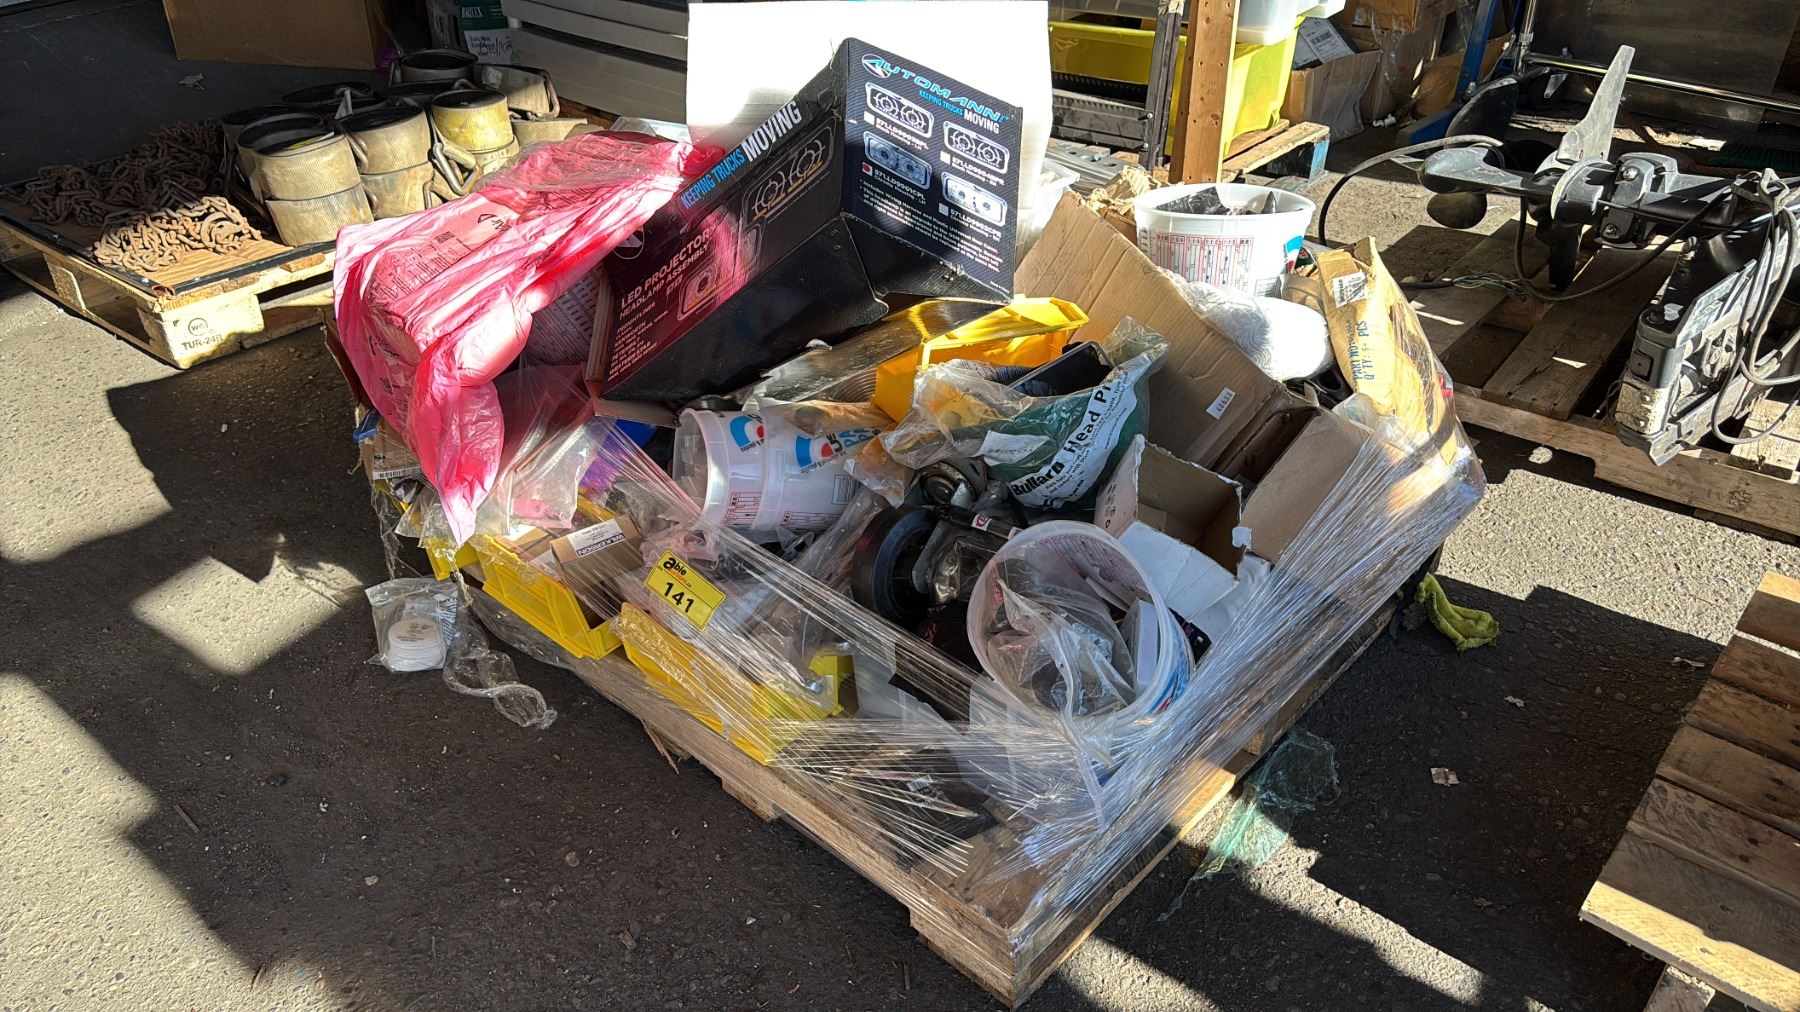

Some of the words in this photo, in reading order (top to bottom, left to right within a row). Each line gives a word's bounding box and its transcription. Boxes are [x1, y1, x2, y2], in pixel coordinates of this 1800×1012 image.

[863, 59, 1002, 122] AUTOMANN
[919, 90, 942, 106] KEEPING
[943, 102, 964, 116] TRUCKS
[964, 108, 1000, 134] MOVING
[680, 174, 716, 209] KEEPING
[710, 148, 746, 182] TRUCKS
[742, 100, 802, 162] MOVING
[619, 280, 664, 320] HEADLAMP
[666, 241, 711, 285] ASSEMBLY
[621, 286, 642, 310] LED
[644, 228, 712, 291] PROJECTOR
[616, 301, 656, 335] FREIGHTLINER
[1356, 320, 1370, 336] PCS
[610, 353, 636, 375] WESTERN
[1350, 360, 1362, 380] PART
[1064, 410, 1101, 454] Head
[663, 557, 687, 576] able
[664, 582, 694, 613] 141
